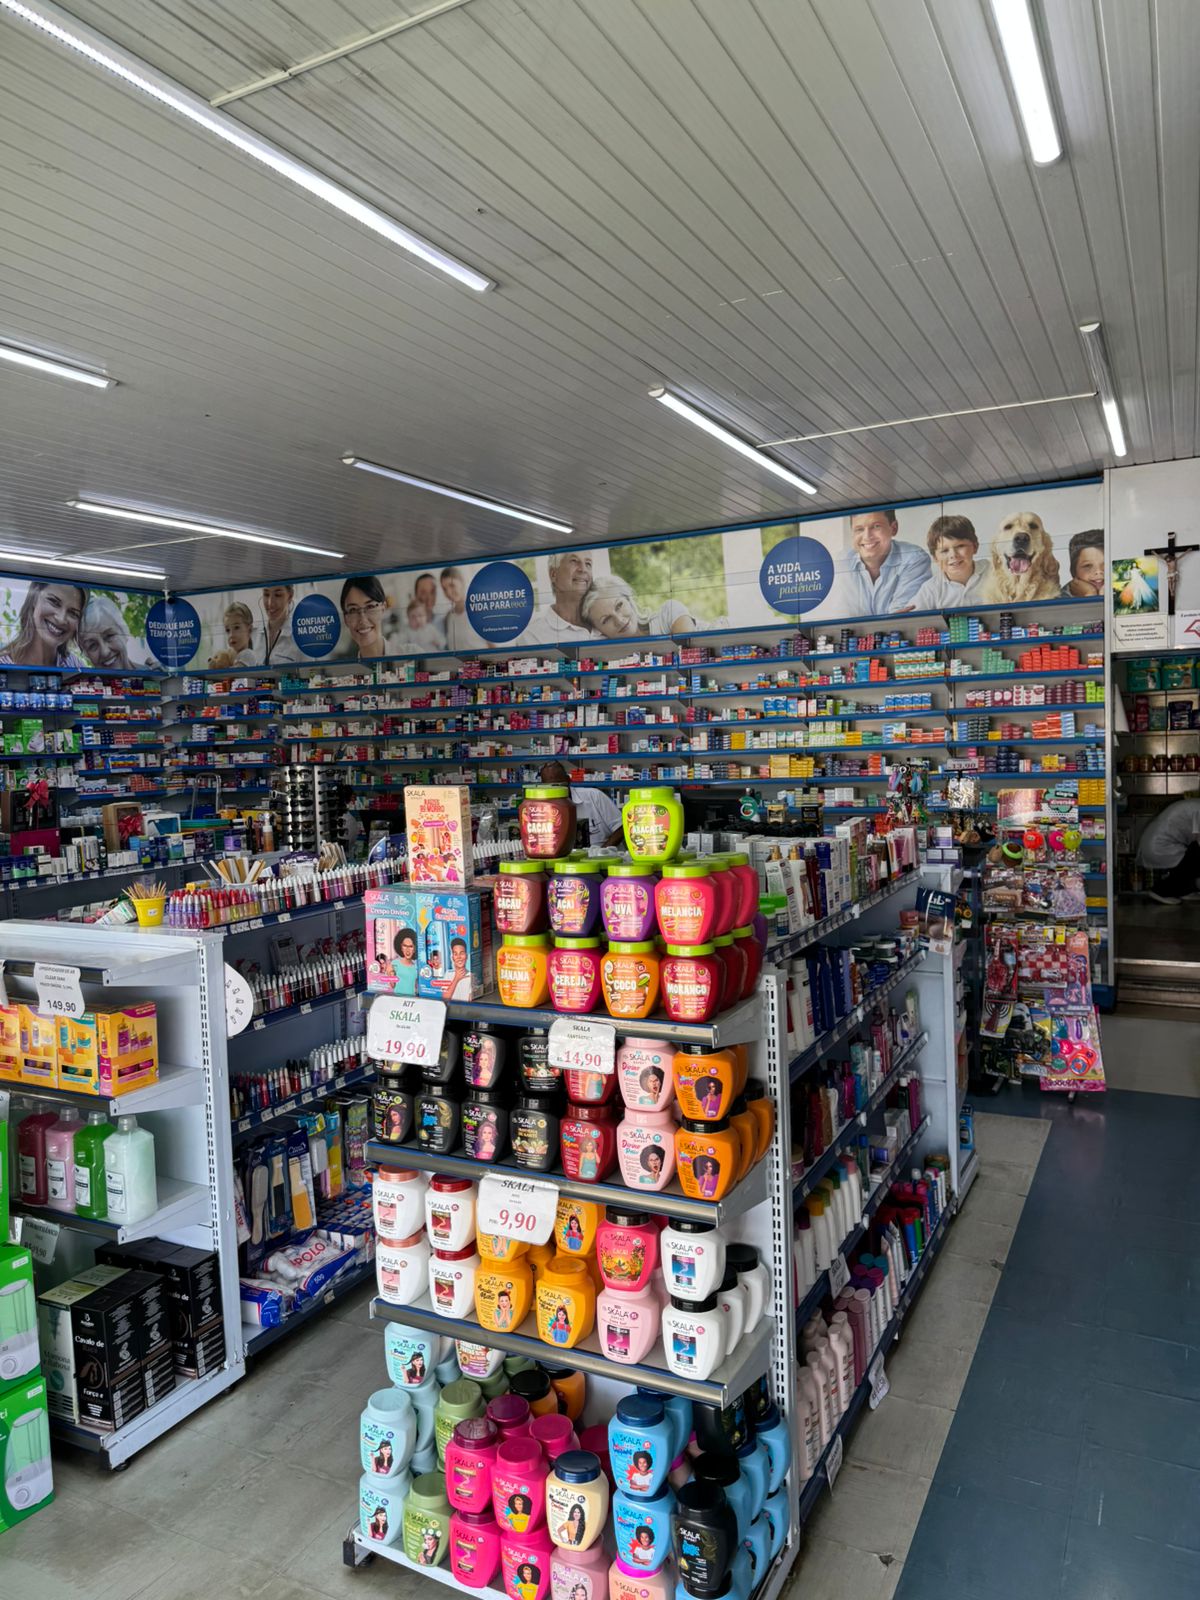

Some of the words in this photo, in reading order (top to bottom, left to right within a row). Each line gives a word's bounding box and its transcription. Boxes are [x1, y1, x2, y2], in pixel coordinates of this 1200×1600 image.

[768, 565, 774, 574] A
[776, 562, 801, 573] VIDA
[768, 574, 792, 586] PEDE
[795, 570, 820, 582] MAIS
[470, 589, 514, 602] QUALIDADE
[515, 588, 526, 598] DE
[470, 602, 488, 612] VIDA
[490, 600, 511, 610] PARA
[148, 620, 178, 630] DEDIQUE
[178, 620, 194, 628] MAIS
[296, 616, 335, 627] CONFIANÇA
[150, 630, 172, 638] TEMPO
[178, 630, 192, 638] SUA
[298, 626, 308, 634] NA
[308, 625, 326, 634] DOSE
[526, 822, 554, 834] CACAU
[632, 824, 664, 834] ABACATE
[498, 898, 521, 910] CACAU
[614, 903, 632, 914] UVA
[661, 906, 702, 918] MELANCIA
[500, 968, 530, 981] BANANA
[556, 974, 587, 986] CEREJA
[613, 980, 636, 992] COCO
[667, 983, 707, 996] MORANGO
[48, 1000, 76, 1012] 149,90
[390, 1010, 420, 1022] SKALA
[385, 1040, 426, 1058] 19,90
[564, 1050, 602, 1067] 14,90
[630, 1053, 650, 1062] SKALA
[685, 1066, 707, 1074] SKALA
[422, 1102, 438, 1110] SKALA
[468, 1110, 486, 1118] SKALA
[518, 1118, 536, 1126] SKALA
[570, 1126, 590, 1134] SKALA
[630, 1131, 652, 1140] SKALA
[684, 1143, 704, 1152] SKALA
[501, 1180, 536, 1192] SKALA
[378, 1190, 396, 1199] SKALA
[431, 1202, 450, 1211] SKALA
[500, 1209, 536, 1232] 9,90
[671, 1242, 694, 1252] SKALA
[381, 1256, 398, 1266] SKALA
[434, 1268, 453, 1278] SKALA
[544, 1290, 562, 1300] SKALA
[608, 1306, 628, 1318] SKALA
[672, 1320, 694, 1332] SKALA
[75, 1335, 96, 1348] Cavalo
[396, 1340, 416, 1349] SKALA
[84, 1388, 98, 1398] Força
[367, 1426, 384, 1436] SKALA
[620, 1434, 642, 1446] SKALA
[454, 1457, 475, 1468] SKALA
[500, 1481, 520, 1490] SKALA
[555, 1488, 576, 1500] SKALA
[411, 1514, 430, 1524] SKALA
[622, 1508, 643, 1520] SKALA
[456, 1530, 476, 1542] SKALA
[680, 1527, 701, 1540] SKALA
[508, 1550, 527, 1560] SKALA
[620, 1582, 639, 1594] SKALA
